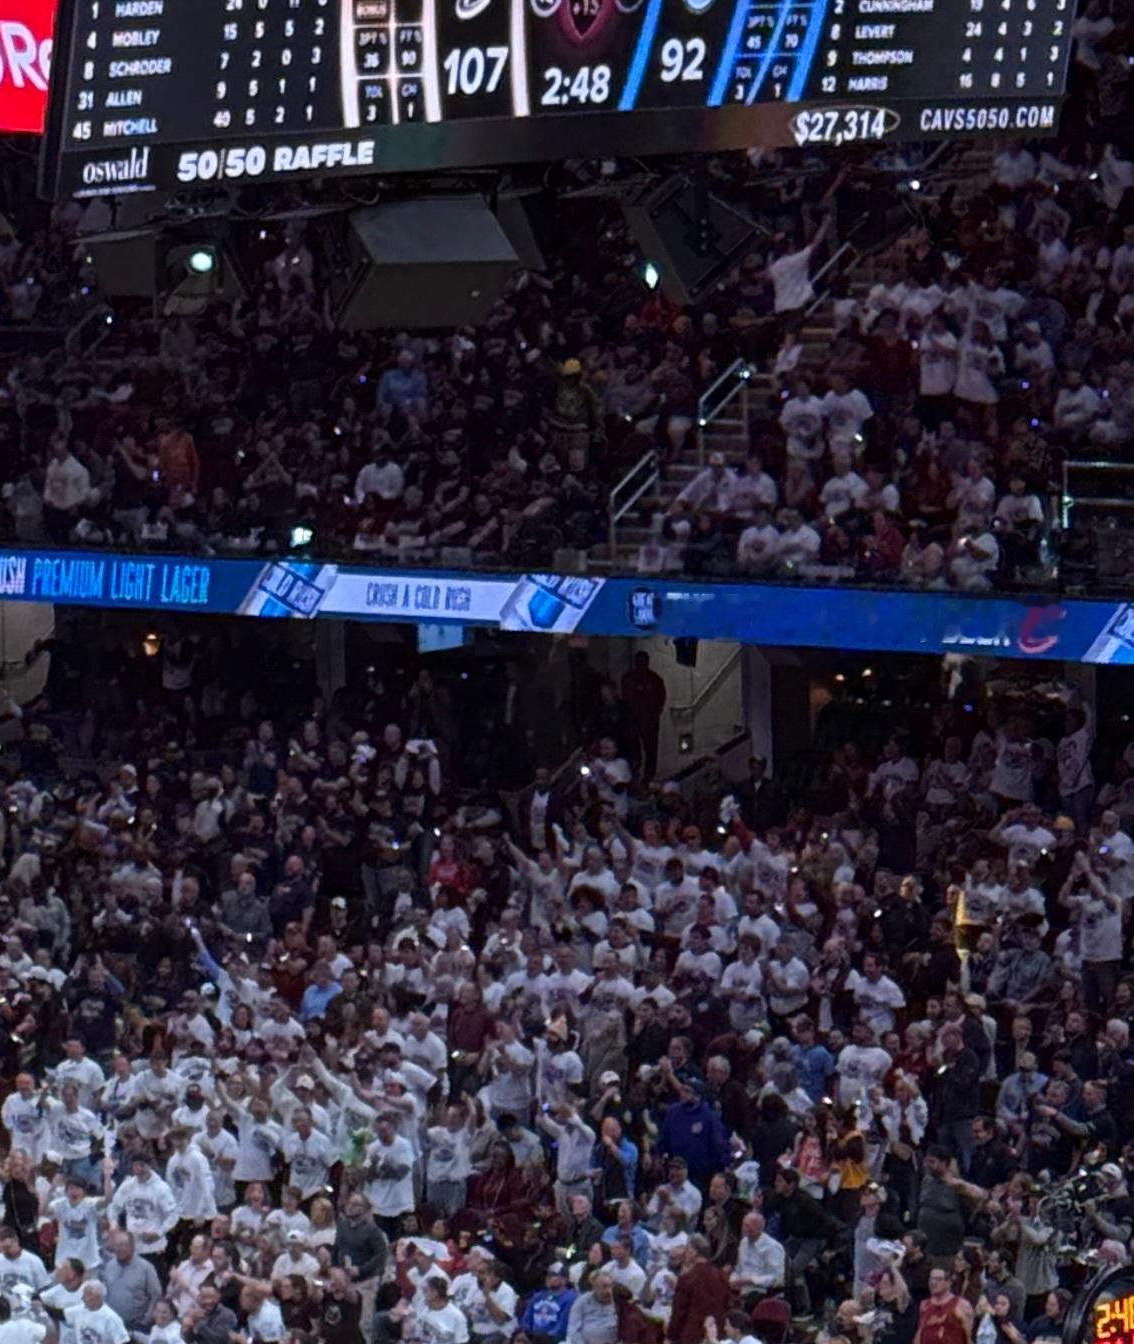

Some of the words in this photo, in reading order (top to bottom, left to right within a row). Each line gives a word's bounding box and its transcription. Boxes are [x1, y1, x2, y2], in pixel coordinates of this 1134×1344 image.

[92, 1, 99, 19] 1
[115, 0, 164, 17] HARDEN
[87, 31, 97, 49] 4
[112, 29, 160, 47] MOBLEY
[224, 24, 238, 41] 15
[255, 22, 265, 38] 5
[285, 20, 294, 36] 5
[315, 19, 325, 35] 2
[830, 24, 841, 40] 8
[855, 24, 895, 39] LEVERT
[966, 22, 982, 37] 24
[84, 62, 94, 80] 8
[220, 53, 229, 70] 7
[252, 51, 261, 67] 2
[282, 49, 291, 65] 0
[311, 47, 321, 64] 3
[443, 46, 509, 95] 107
[660, 37, 706, 82] 92
[827, 50, 838, 67] 9
[852, 51, 914, 65] THOMPSON
[79, 92, 94, 109] 31
[106, 90, 142, 107] ALLEN
[279, 79, 286, 94] 1
[309, 77, 316, 92] 1
[541, 65, 611, 105] 2:48
[822, 76, 836, 92] 12
[848, 77, 888, 91] HARRIS
[73, 123, 91, 140] 45
[103, 119, 158, 136] MITCHELL
[246, 110, 255, 125] 5
[275, 107, 285, 123] 2
[306, 106, 313, 121] 1
[794, 109, 885, 144] $27,314
[920, 106, 1055, 131] CAVS5050.COM
[83, 146, 150, 184] oswald
[274, 141, 375, 171] RAFFLE
[31, 558, 104, 600] PREMIUM
[111, 562, 155, 601] LIGHT
[161, 565, 211, 604] LAGER
[366, 582, 398, 606] CRUSH
[402, 584, 410, 607] A
[414, 585, 440, 610] COLD
[445, 586, 471, 611] RUSH
